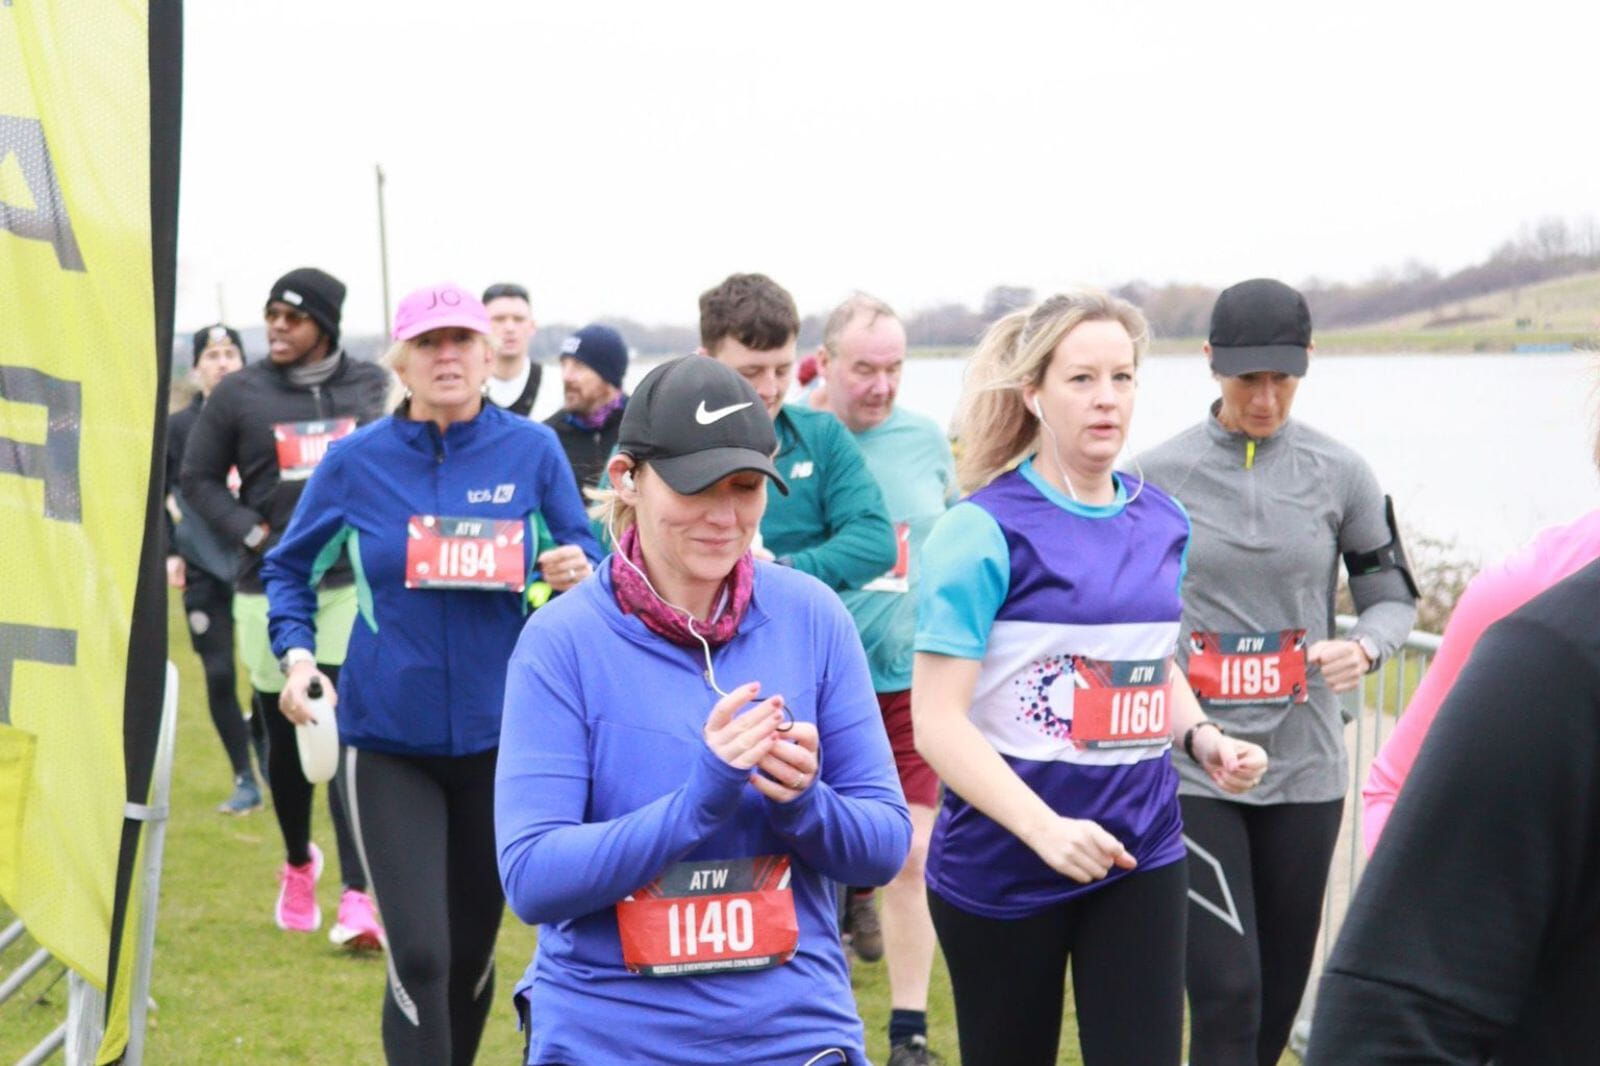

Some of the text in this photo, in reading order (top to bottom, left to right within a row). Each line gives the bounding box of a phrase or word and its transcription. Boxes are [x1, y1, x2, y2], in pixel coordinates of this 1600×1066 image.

[427, 289, 461, 310] JO
[455, 521, 483, 536] ATW
[439, 541, 497, 577] 1194
[1236, 637, 1265, 653] ATW
[1129, 665, 1156, 683] ATW
[1221, 656, 1281, 695] 1195
[1110, 689, 1165, 735] 1160
[689, 869, 729, 891] ATW
[668, 899, 754, 957] 1140
